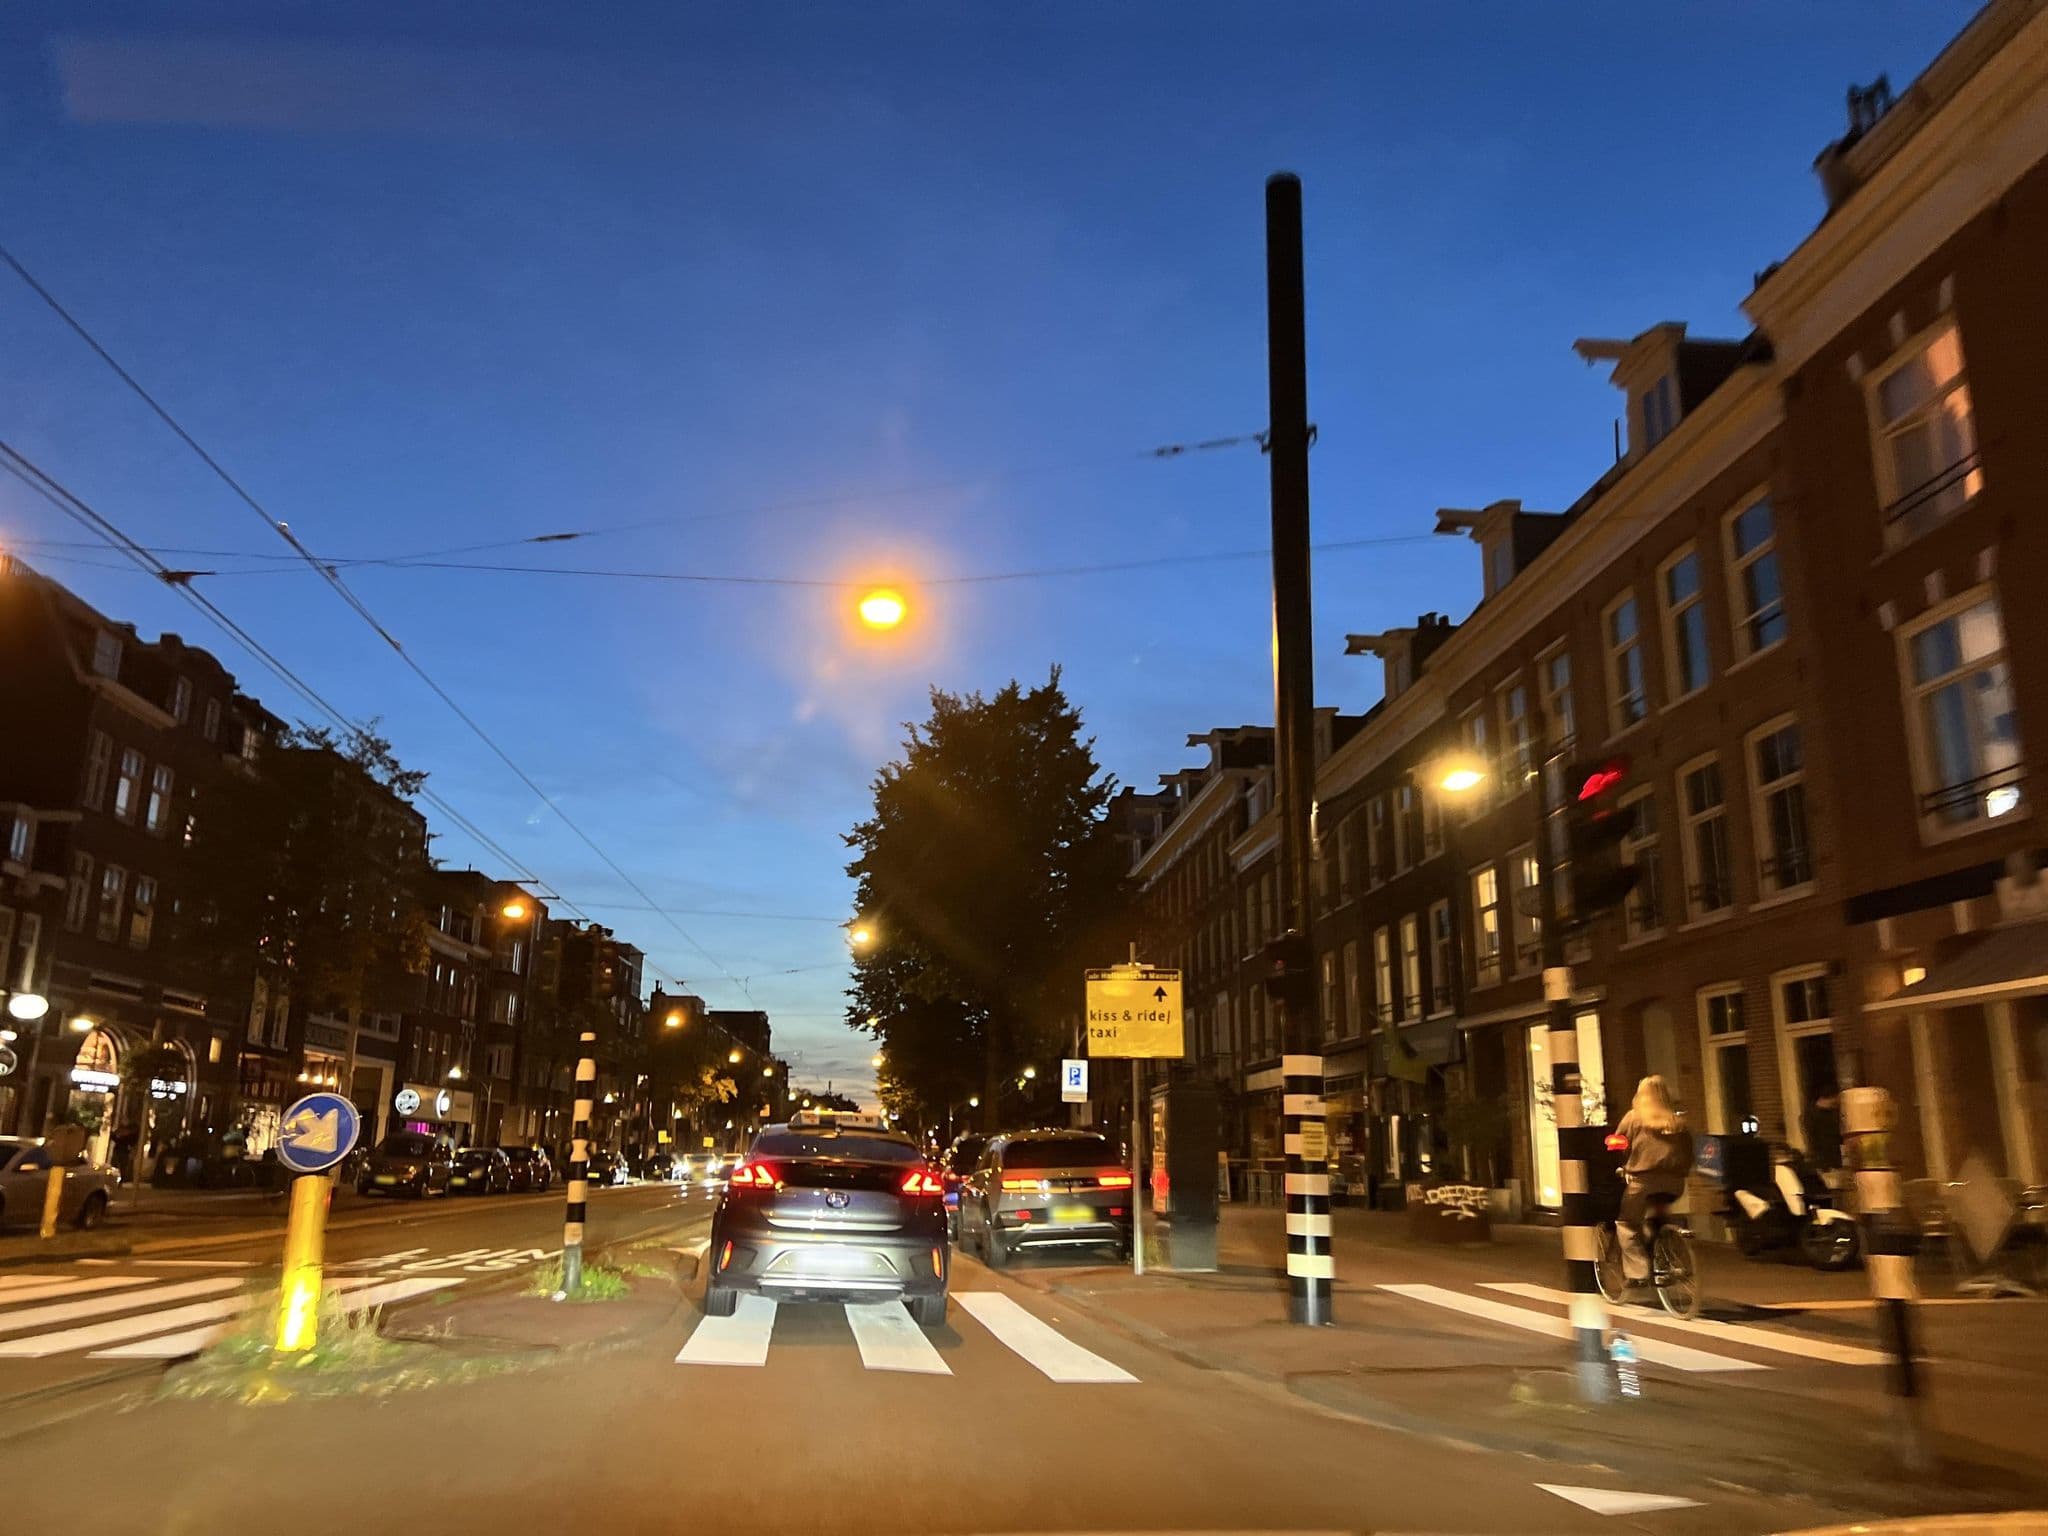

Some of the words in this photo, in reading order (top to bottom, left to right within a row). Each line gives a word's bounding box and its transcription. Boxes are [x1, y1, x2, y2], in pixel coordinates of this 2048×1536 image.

[1090, 1009, 1117, 1021] kiss
[1122, 1009, 1132, 1022] &
[1137, 1009, 1171, 1025] ride/
[1090, 1026, 1117, 1038] taxi
